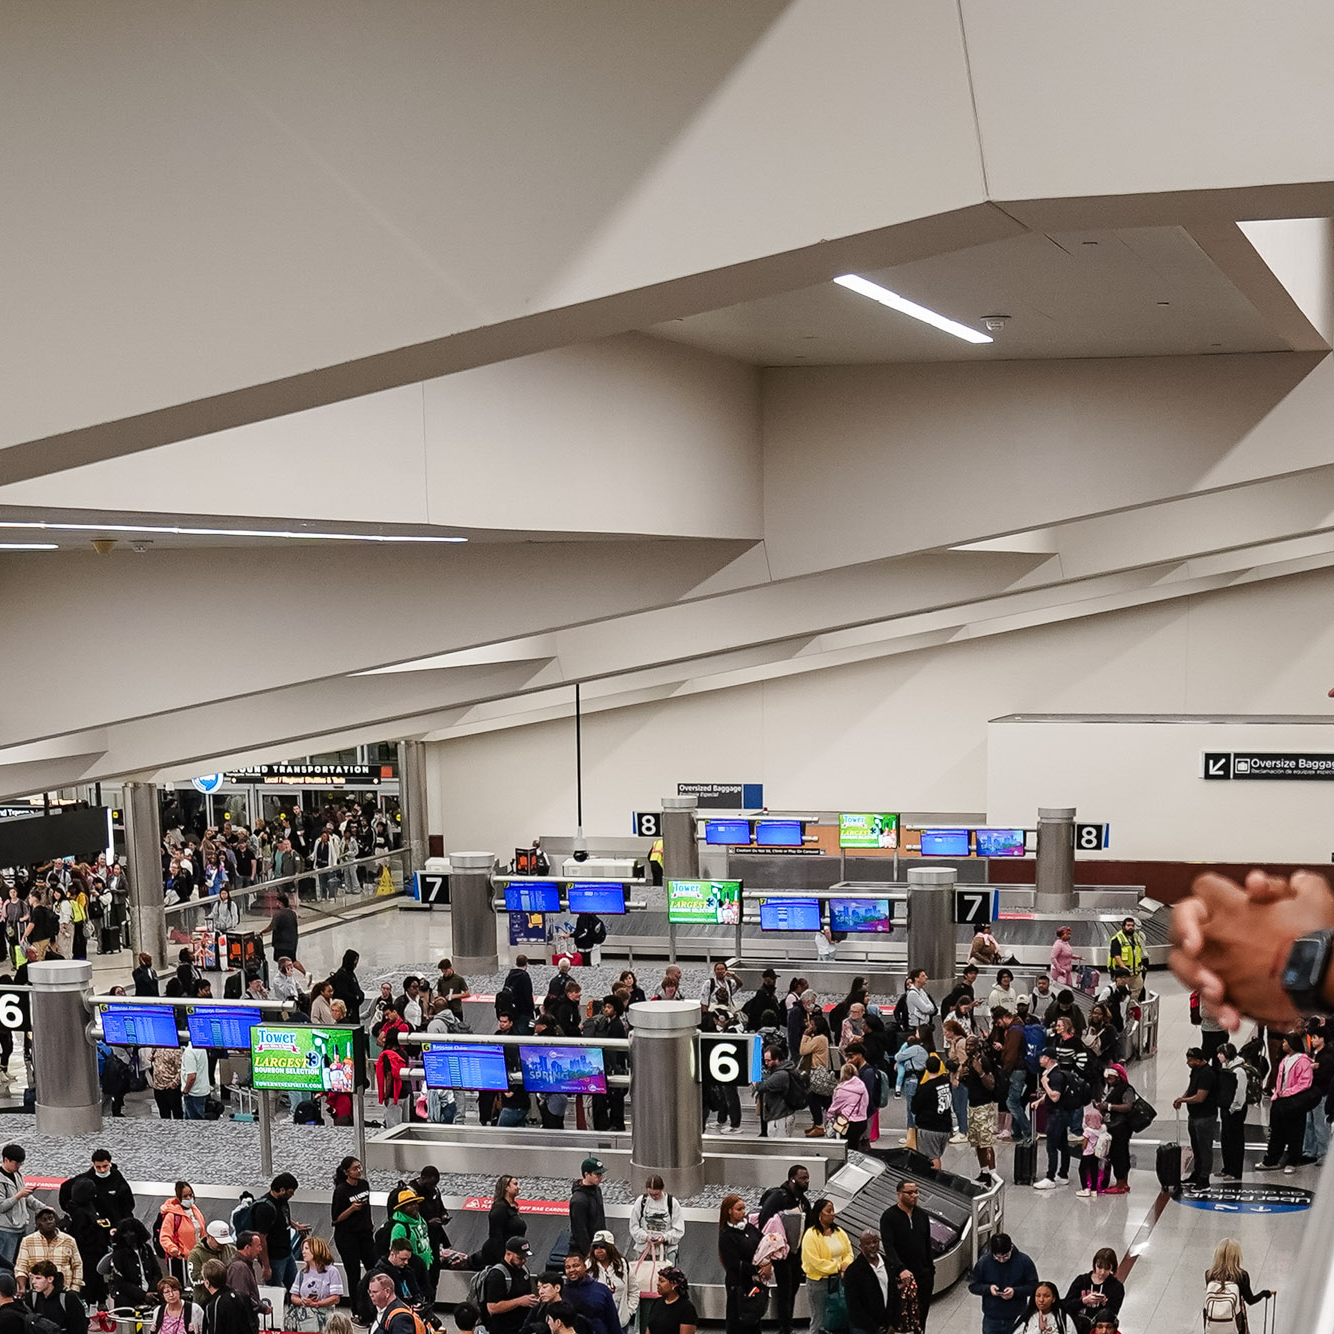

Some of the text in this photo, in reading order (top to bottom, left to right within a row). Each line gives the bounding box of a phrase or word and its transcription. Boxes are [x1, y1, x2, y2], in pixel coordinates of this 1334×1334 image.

[272, 765, 369, 774] TRANSPORTATION
[1251, 759, 1296, 768] Oversize
[713, 785, 742, 793] Baggage
[641, 815, 656, 836] 8
[1081, 826, 1097, 848] 8
[426, 877, 443, 901] 7
[674, 882, 700, 892] Tower
[964, 895, 983, 921] 7
[259, 1030, 295, 1044] Tower
[423, 1043, 430, 1051] 6
[254, 1056, 309, 1068] LARGEST
[709, 1043, 739, 1082] 6
[254, 1066, 320, 1075] BOURBON SELECTION
[1183, 1190, 1311, 1204] Uber Pickup
